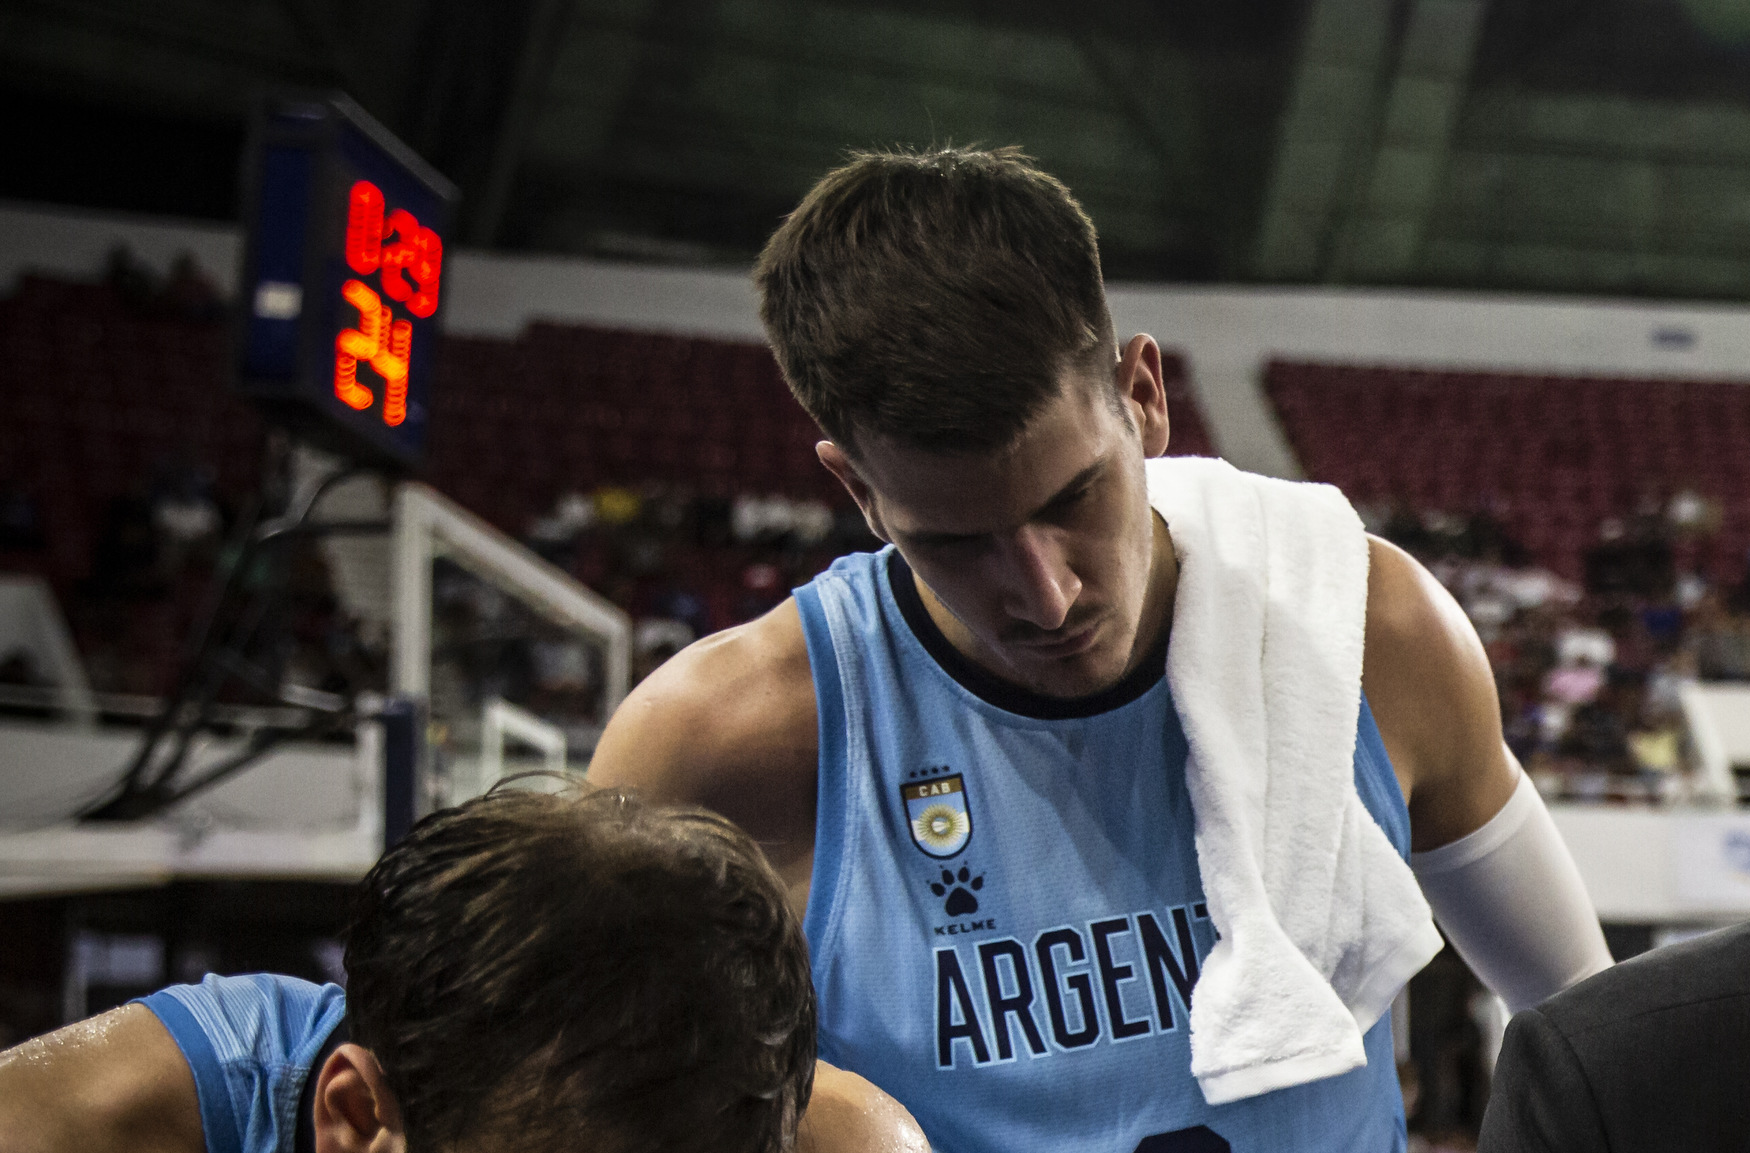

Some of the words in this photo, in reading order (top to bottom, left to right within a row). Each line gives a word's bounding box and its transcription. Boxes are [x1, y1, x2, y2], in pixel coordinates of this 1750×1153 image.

[335, 279, 412, 427] 24
[918, 781, 951, 797] CAB
[934, 919, 997, 936] KELME
[934, 902, 1221, 1069] ARGEN
